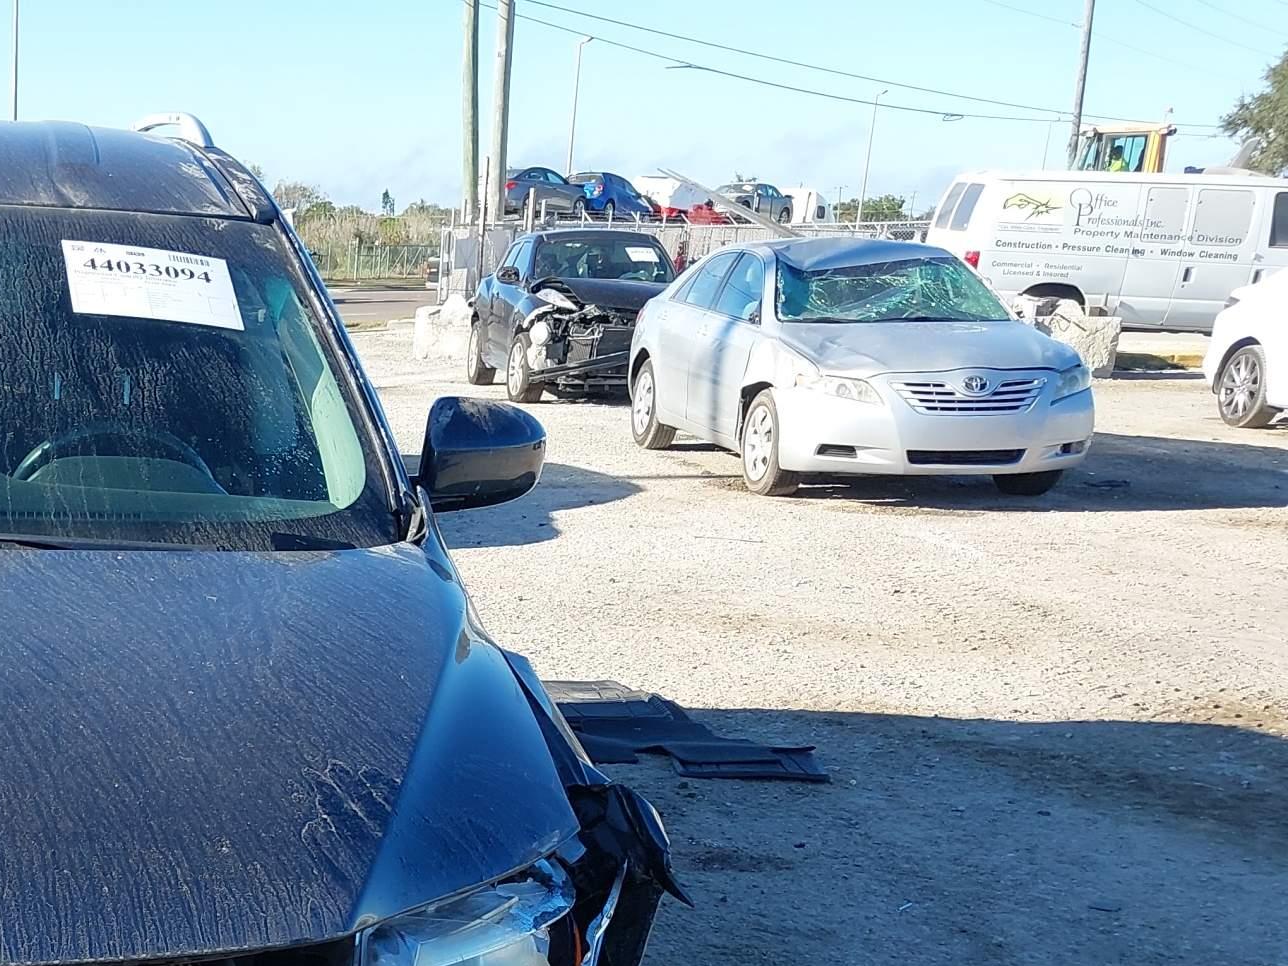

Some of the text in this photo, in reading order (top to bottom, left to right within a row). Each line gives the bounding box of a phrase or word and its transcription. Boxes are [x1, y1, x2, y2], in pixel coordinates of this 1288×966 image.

[1070, 187, 1118, 209] Office
[1073, 203, 1165, 228] Professionals Inc.
[1073, 227, 1120, 238] Property
[1124, 230, 1193, 242] Maintenance
[1196, 234, 1243, 244] Division
[995, 239, 1053, 250] Construction
[1062, 242, 1101, 252] Pressure
[1160, 248, 1195, 258] Window
[1199, 250, 1239, 262] Cleaning
[83, 257, 212, 283] 44033094
[991, 260, 1083, 271] Commercial Residential
[1002, 269, 1034, 277] Licensed
